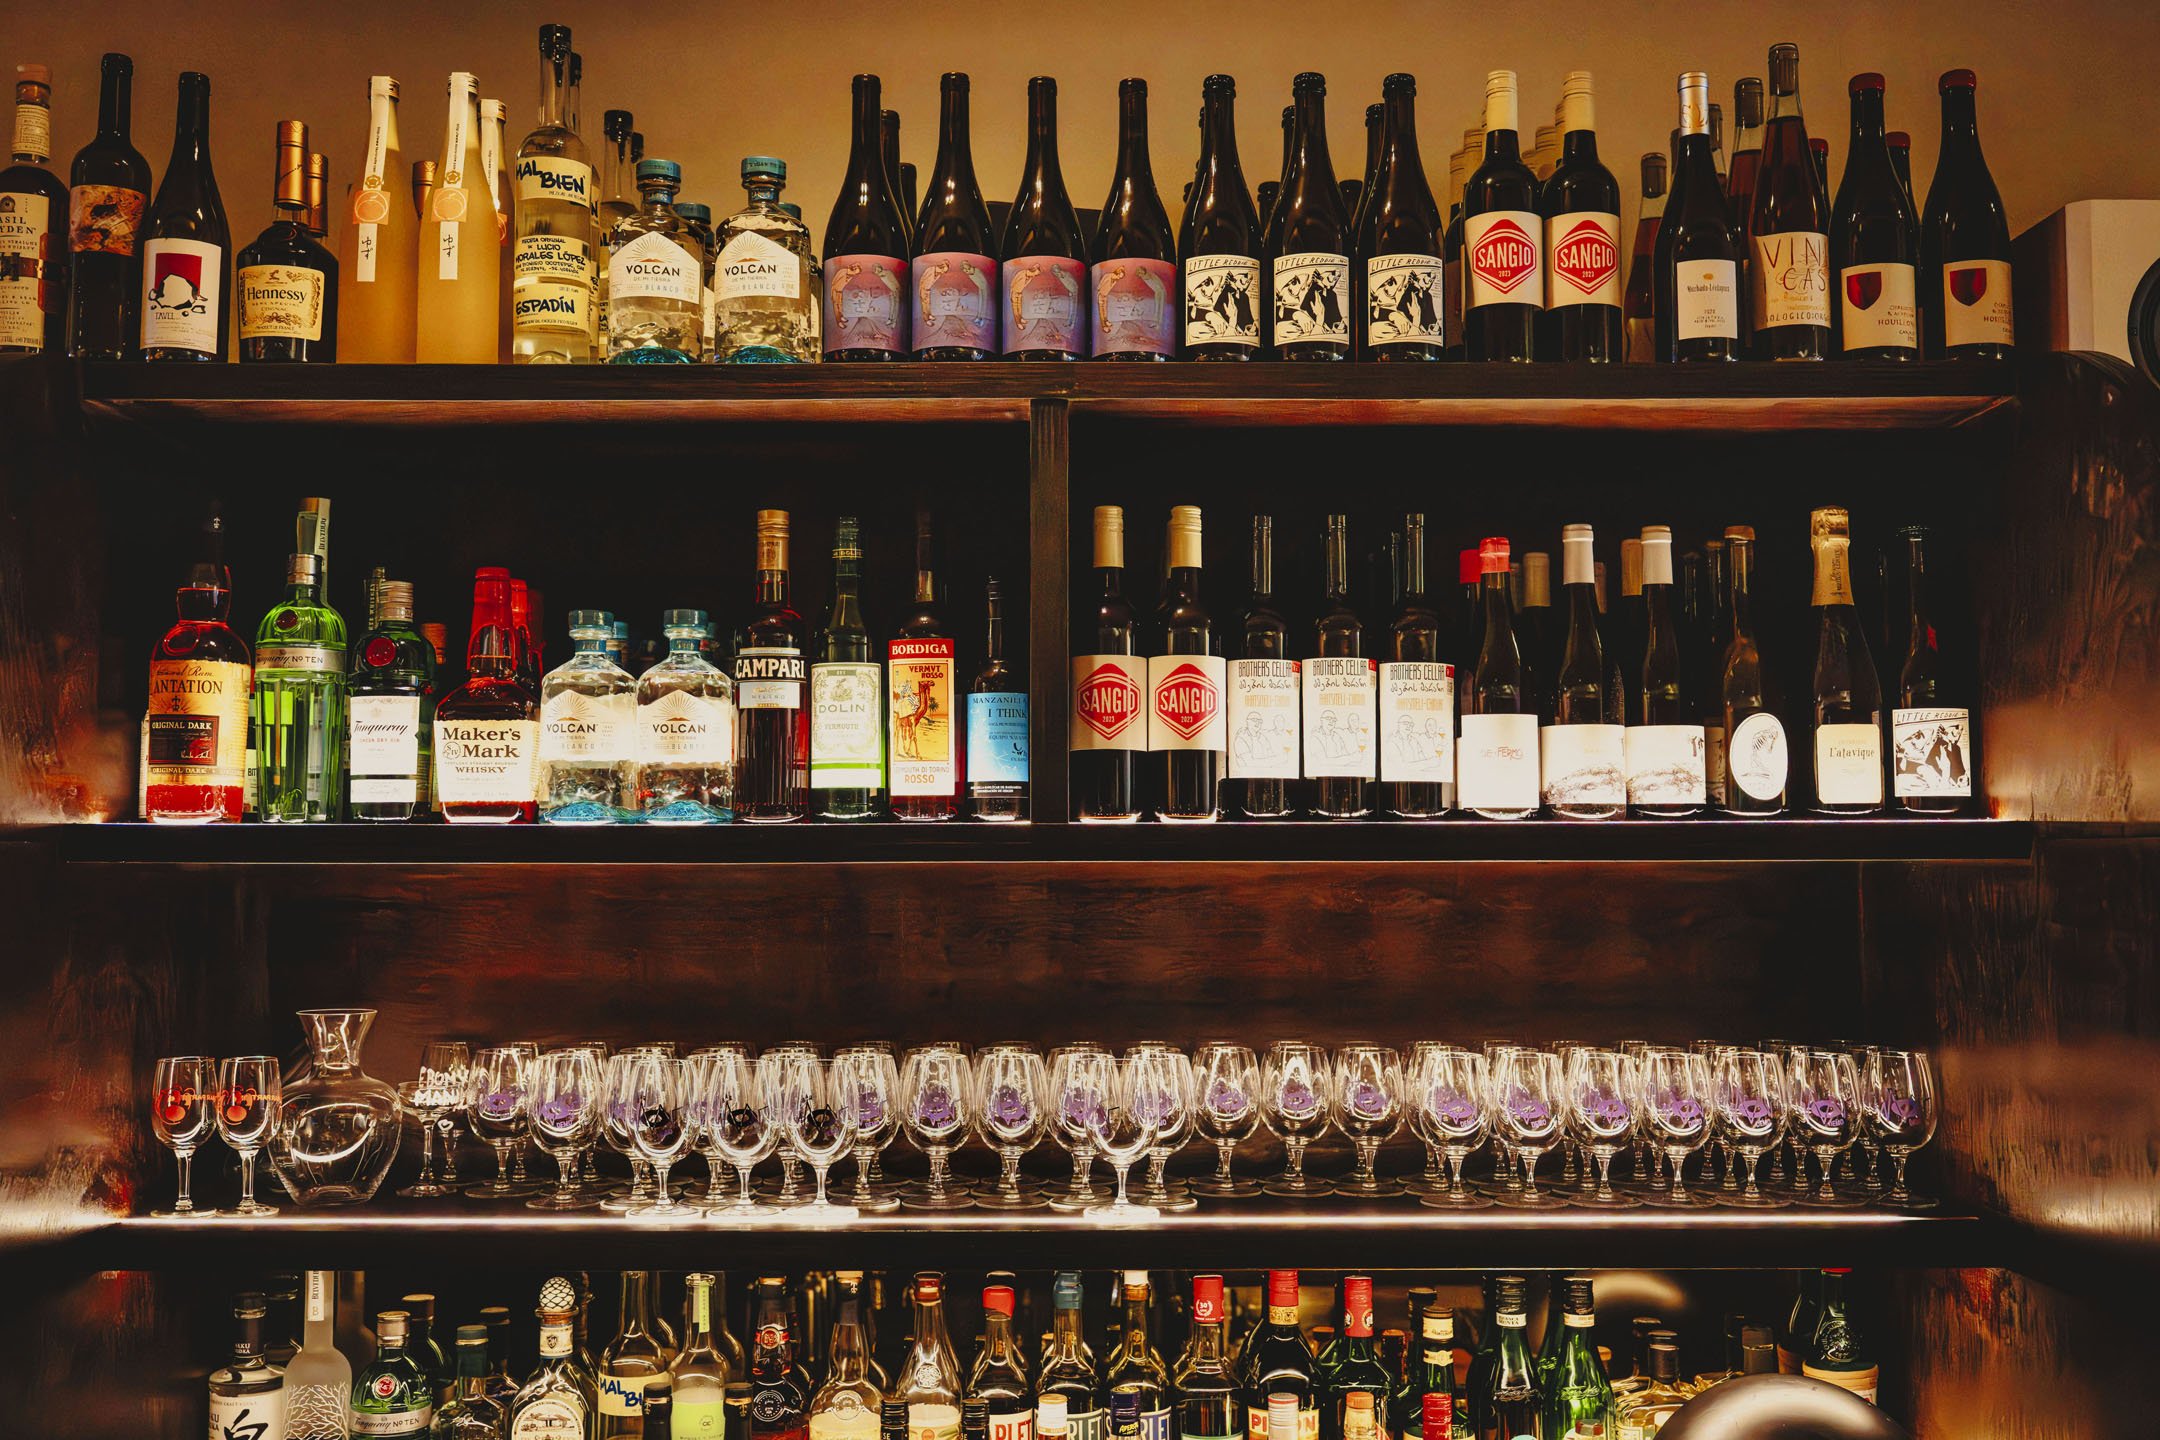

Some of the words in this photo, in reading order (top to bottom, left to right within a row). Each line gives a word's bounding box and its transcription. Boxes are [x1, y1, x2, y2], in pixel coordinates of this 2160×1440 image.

[541, 171, 584, 195] BIEN
[0, 216, 26, 224] ASIL
[0, 226, 35, 234] YDEN
[516, 252, 554, 262] MORALES
[558, 251, 586, 266] LÓPEZ
[1478, 242, 1531, 268] SANGIO
[1560, 243, 1613, 269] SANGIO
[626, 265, 680, 276] VOLCAN
[725, 264, 776, 276] VOLCAN
[1188, 258, 1219, 272] LITTLE
[1276, 258, 1305, 272] LITTLE
[1372, 258, 1403, 272] LITTLE
[247, 286, 308, 303] Hennessy
[645, 284, 679, 293] BLANCO
[516, 296, 575, 314] ESPADÍN
[892, 644, 948, 655] BORDIGA
[736, 658, 806, 679] CAMPARI
[1239, 661, 1270, 677] BROTHERS
[1272, 661, 1292, 677] CELLAR
[1313, 660, 1343, 676] BROTHERS
[1346, 660, 1367, 676] CELLAR
[1390, 664, 1421, 680] BROTHERS
[1424, 664, 1444, 680] CELLAR
[154, 679, 222, 694] ANTATION
[1082, 687, 1135, 713] SANGIO
[1160, 687, 1214, 714] SANGIO
[818, 704, 865, 713] DOLIN
[996, 708, 1027, 718] THINK
[1897, 712, 1931, 723] LITTLE
[152, 722, 184, 730] ORIGINAL
[188, 722, 212, 730] DARK
[354, 720, 408, 735] Tanqueray
[547, 723, 596, 733] VOLCAN
[653, 724, 706, 734] VOLCAN
[442, 728, 521, 741] Maker's
[462, 744, 520, 758] Mark
[904, 774, 934, 784] ROSSO
[625, 1392, 643, 1408] BI
